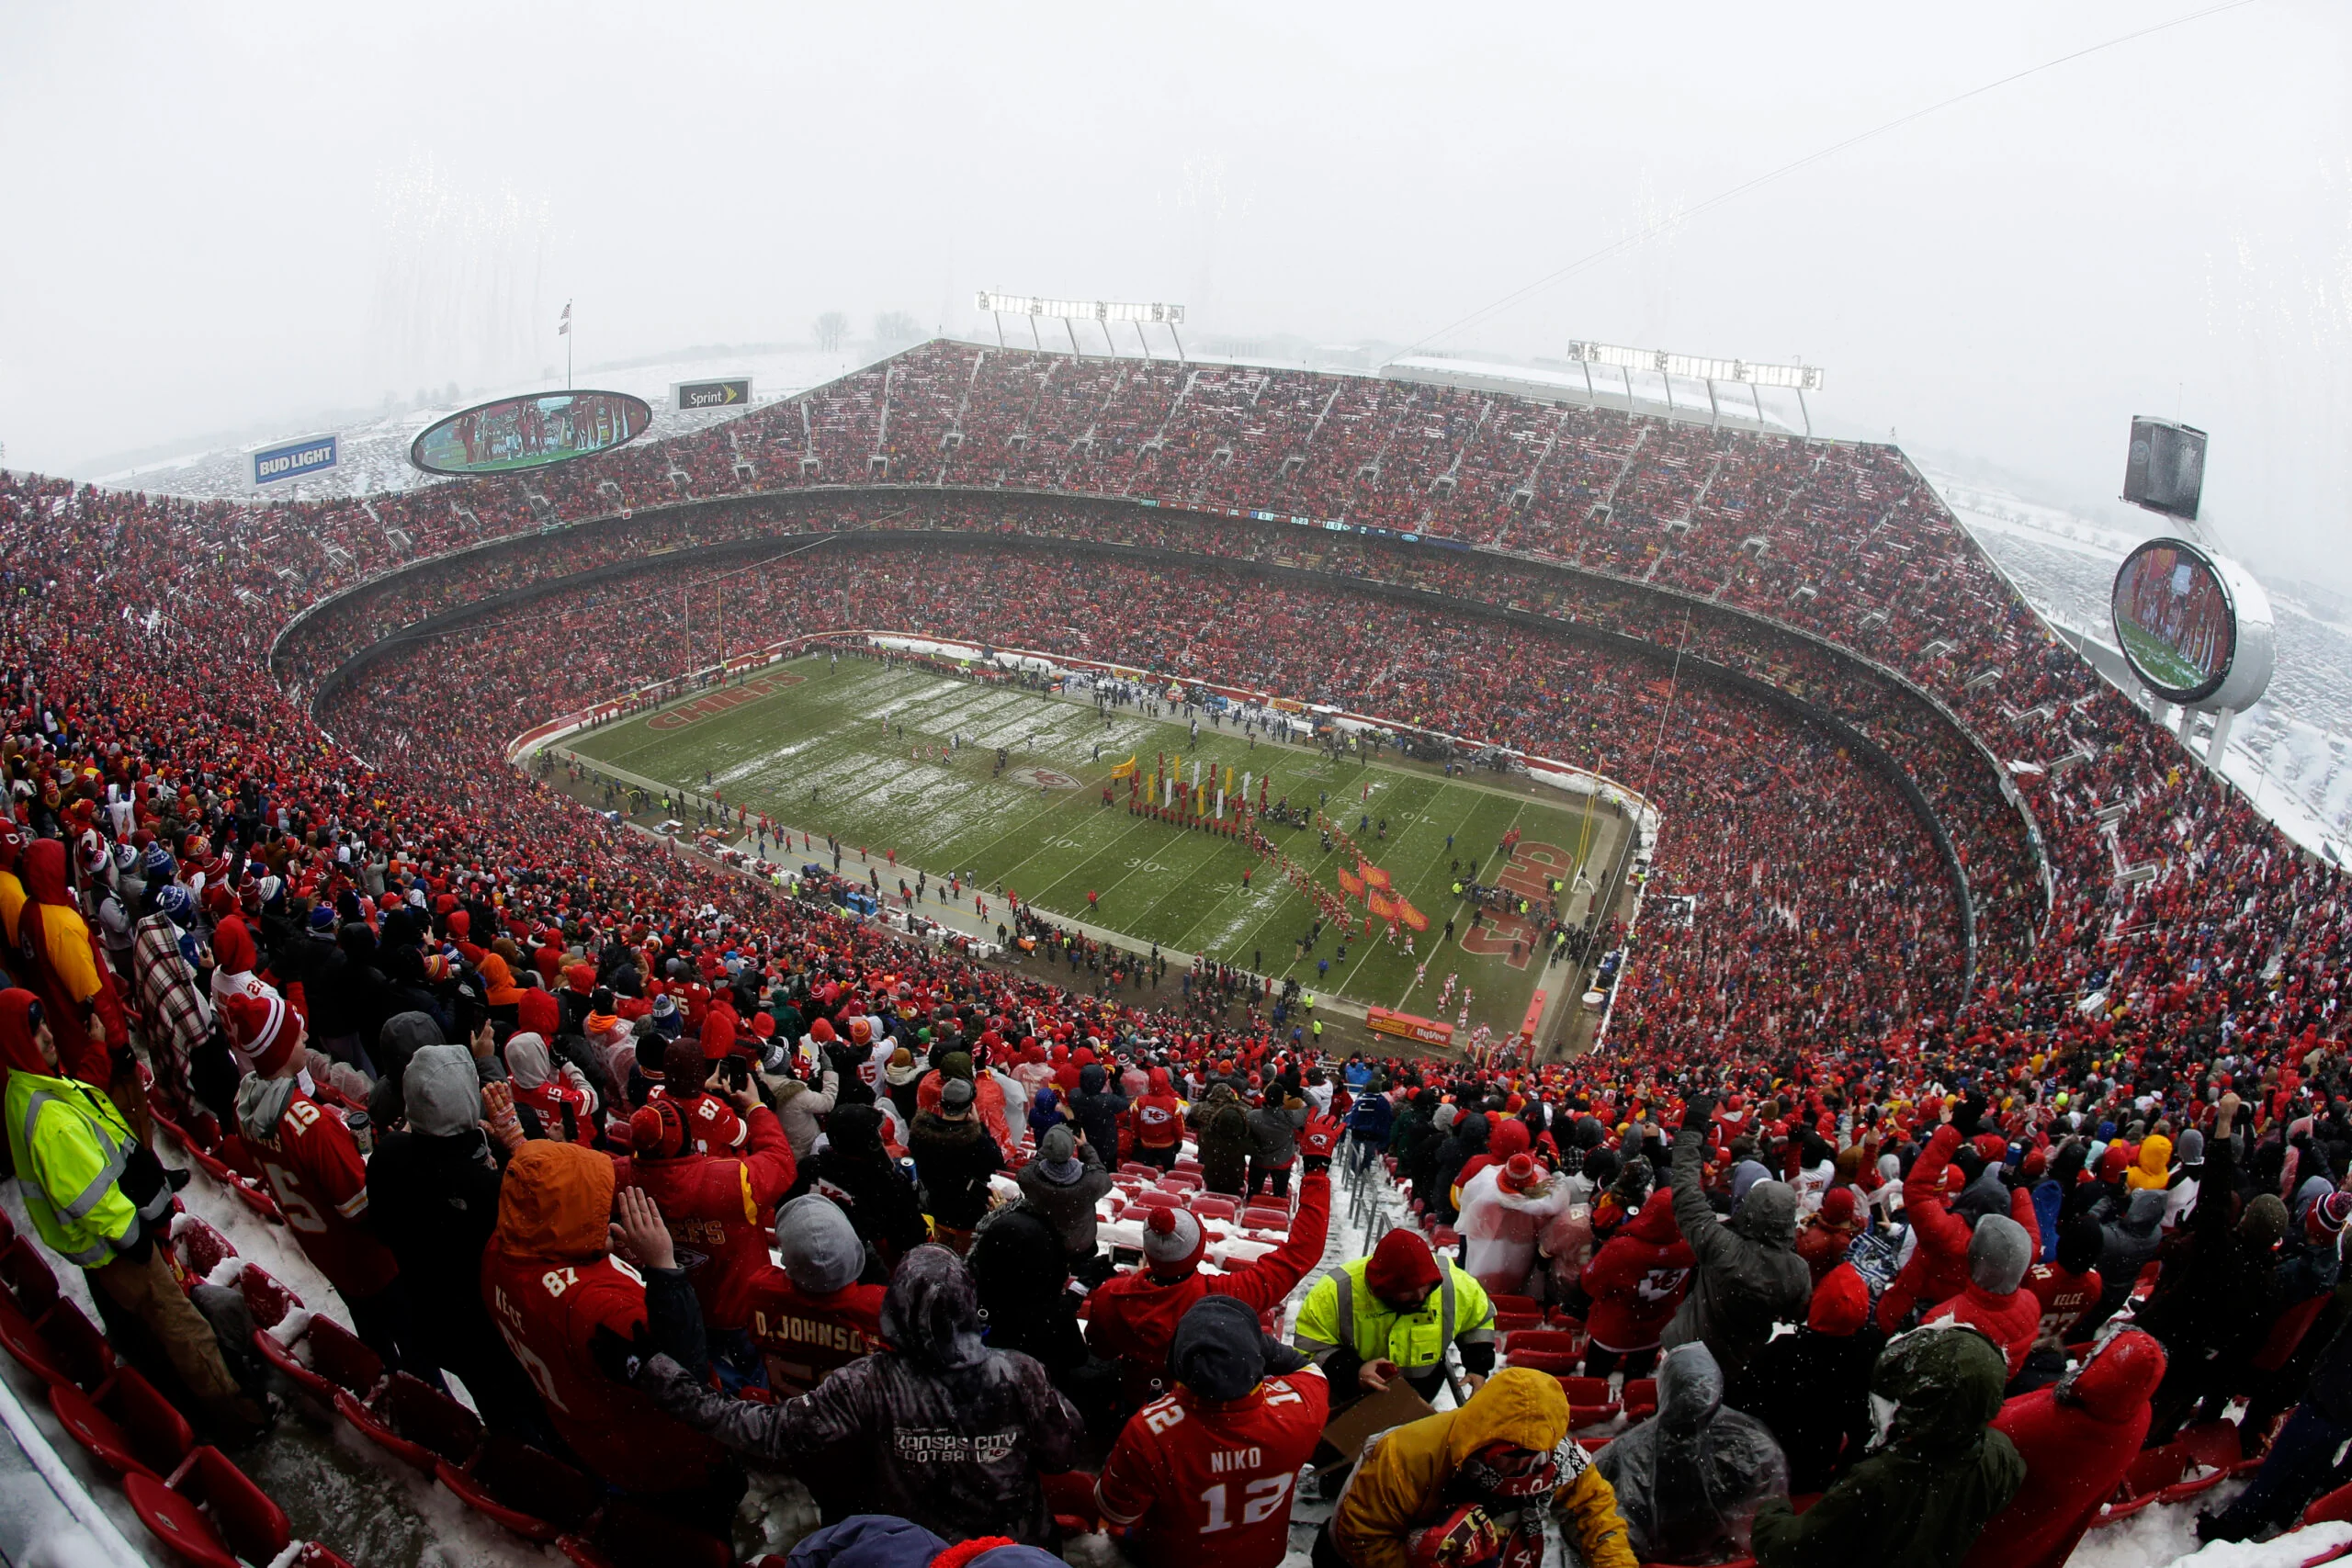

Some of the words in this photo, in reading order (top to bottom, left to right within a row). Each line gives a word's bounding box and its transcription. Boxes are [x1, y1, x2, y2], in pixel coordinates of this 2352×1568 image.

[690, 390, 722, 407] Sprint
[259, 457, 290, 477] BUD
[291, 446, 332, 468] LIGHT
[647, 671, 808, 731] CHIEFS
[1124, 858, 1160, 873] 30
[1213, 883, 1254, 897] 20
[246, 980, 265, 996] 27
[1416, 1027, 1447, 1042] HyVee
[855, 1065, 876, 1083] 15
[547, 1087, 562, 1103] 15
[283, 1100, 322, 1138] 15
[697, 1098, 720, 1121] 87
[542, 1267, 580, 1298] 87
[2052, 1292, 2085, 1306] KELCE
[1141, 1395, 1186, 1437] 12
[893, 1435, 968, 1450] KANSAS
[974, 1431, 1017, 1450] CITY
[1210, 1446, 1261, 1474] NIKO
[1197, 1471, 1295, 1535] 12
